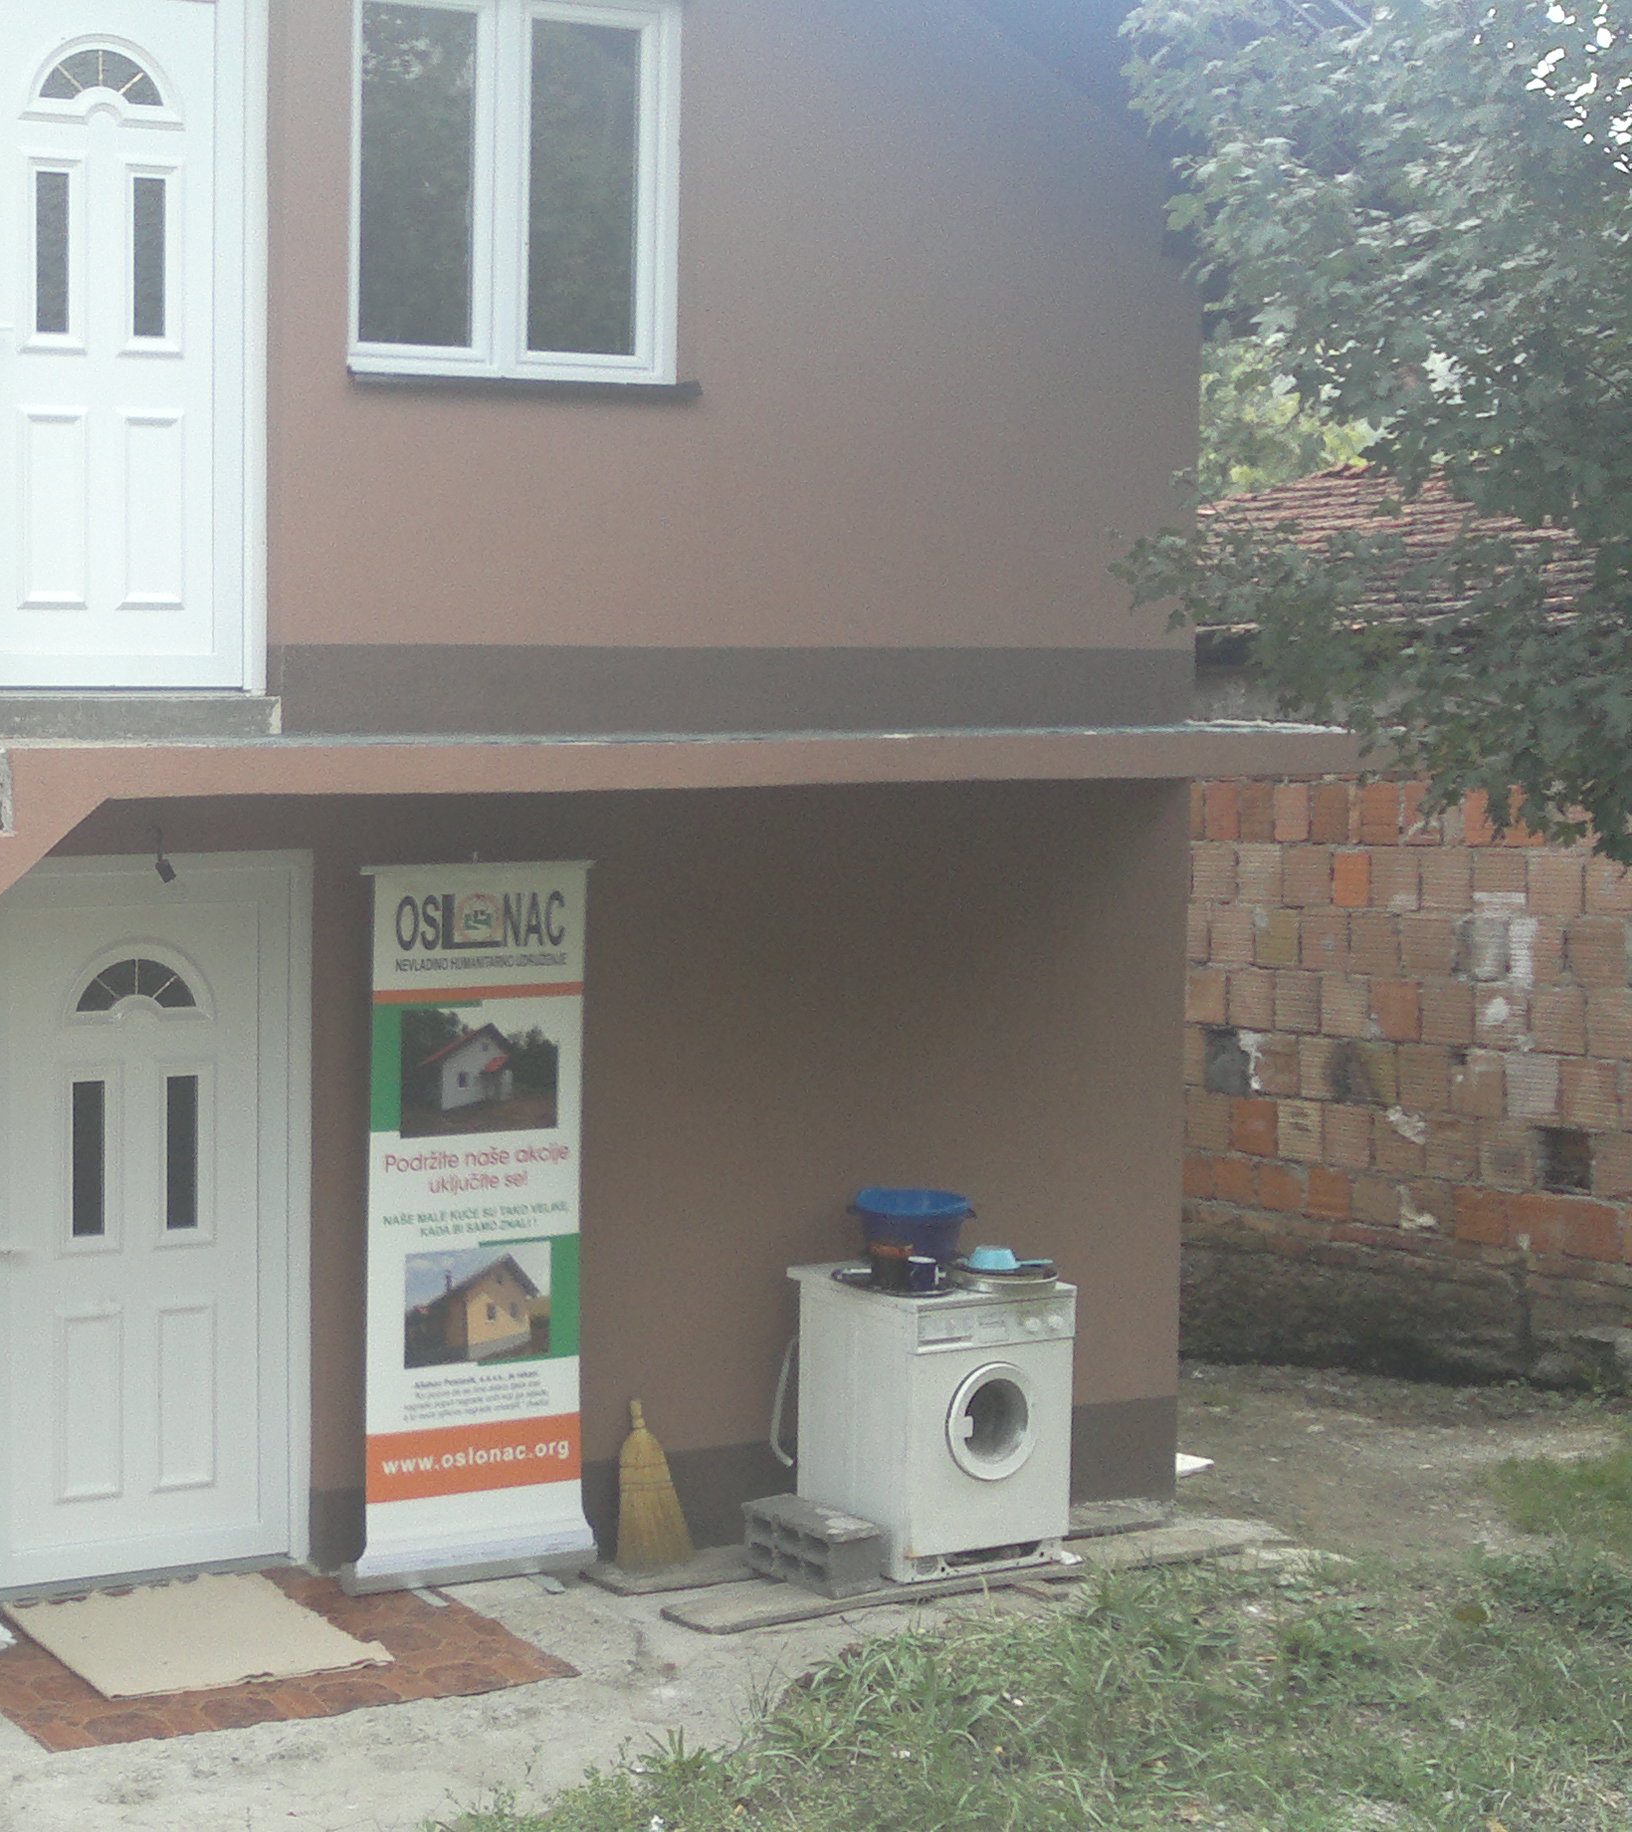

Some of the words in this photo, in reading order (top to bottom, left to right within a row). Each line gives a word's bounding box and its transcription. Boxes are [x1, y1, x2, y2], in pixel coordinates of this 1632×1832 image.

[395, 957, 448, 972] NEVLADINO
[385, 1152, 459, 1173] Podržite
[465, 1146, 510, 1167] naše
[515, 1142, 569, 1165] akcije
[429, 1173, 500, 1195] uključite
[383, 1212, 415, 1225] NAŠE
[381, 1440, 569, 1475] www.oslonac.org
